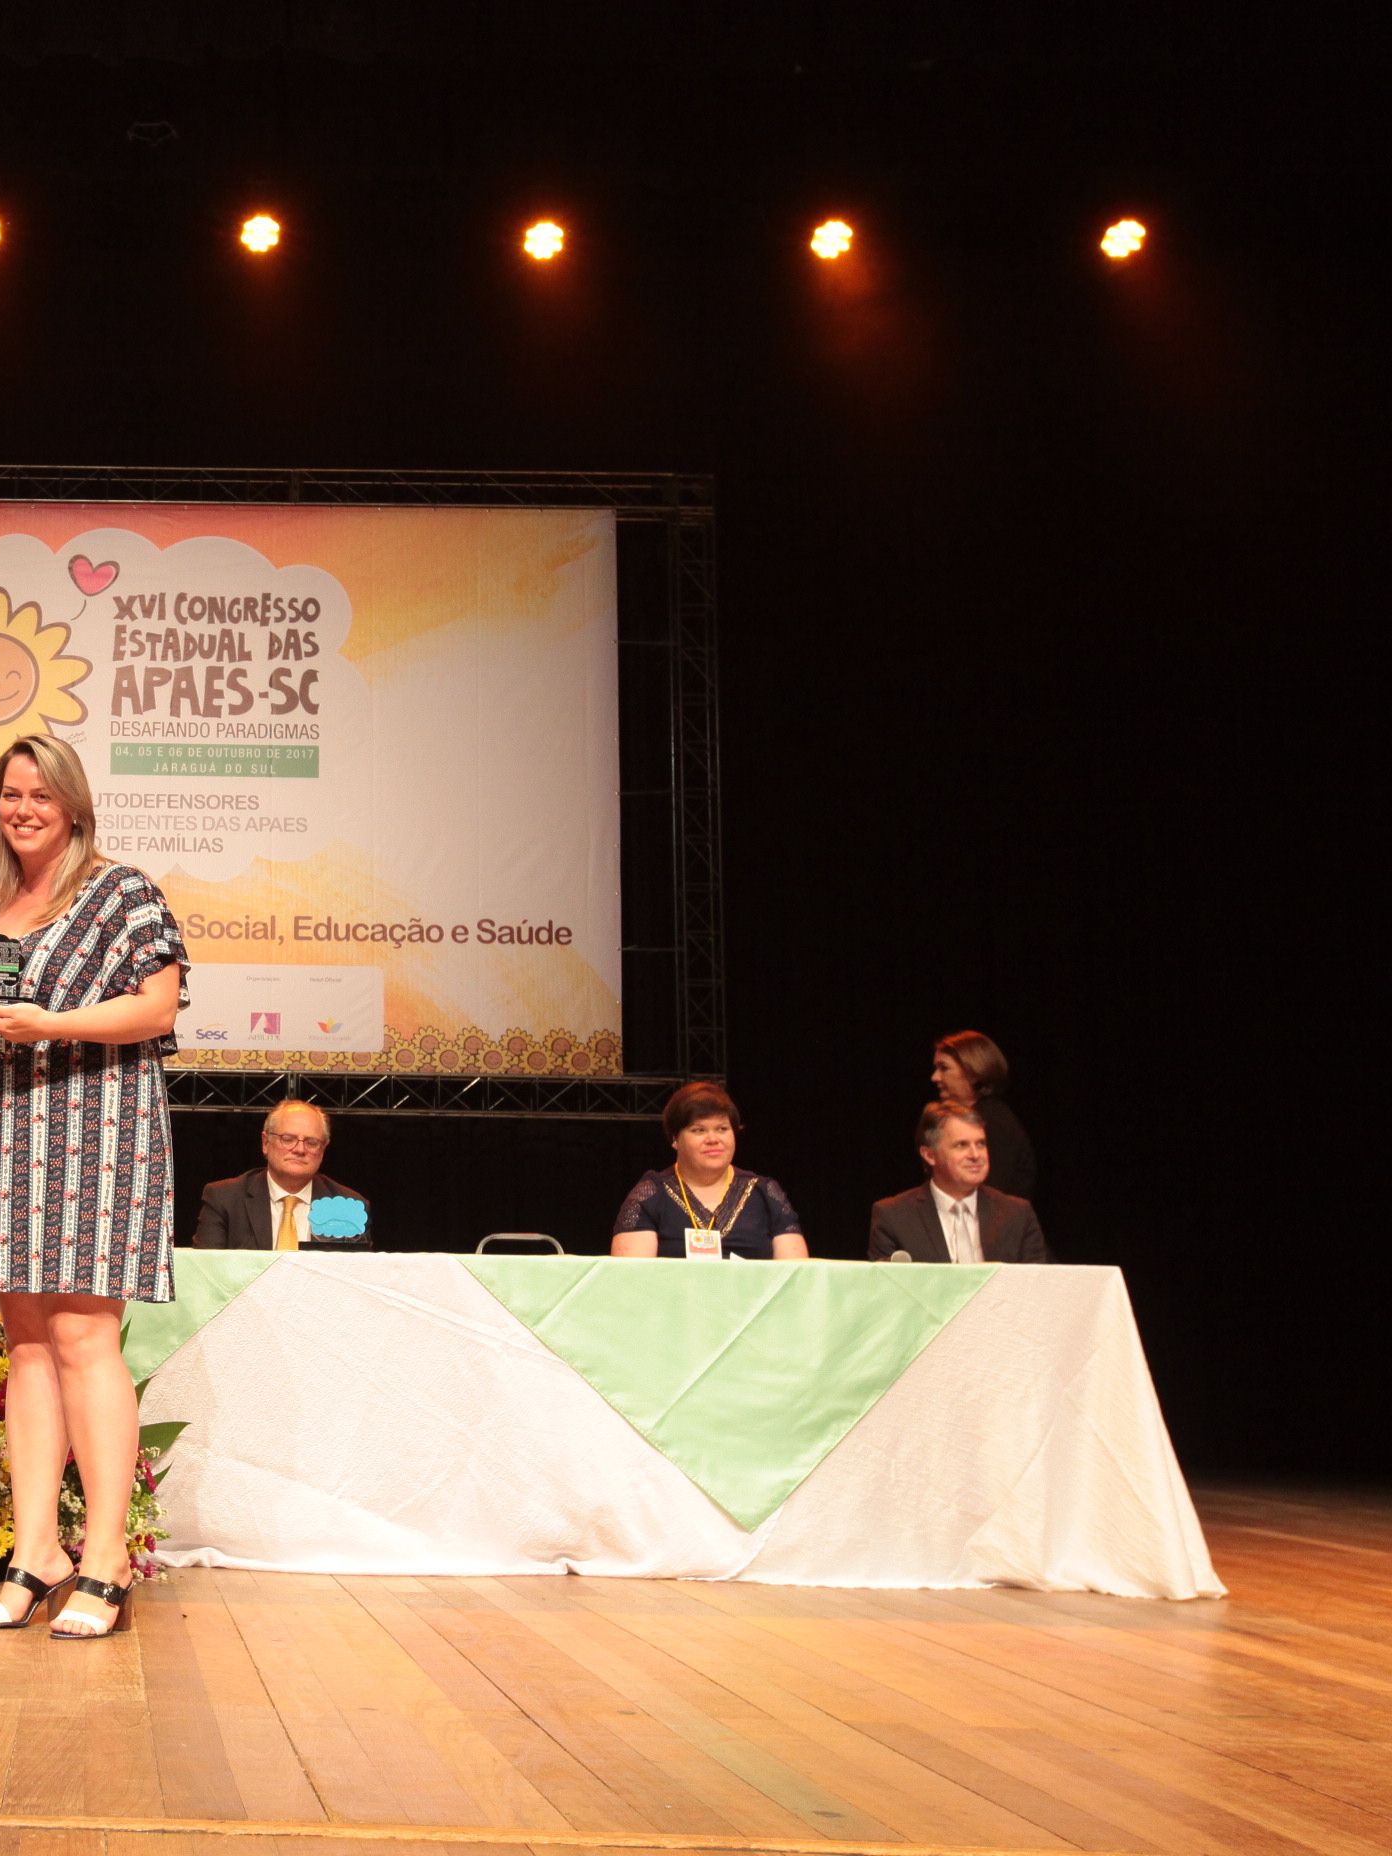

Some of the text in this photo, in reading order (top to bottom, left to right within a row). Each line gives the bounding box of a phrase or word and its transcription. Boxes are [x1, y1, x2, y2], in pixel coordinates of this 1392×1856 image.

[112, 592, 321, 627] XVI CONGRESSO
[112, 624, 320, 663] ESTADUAL DAS
[111, 664, 320, 719] APAES-SC
[110, 721, 320, 740] DESAFIANDO PARADIGMAS
[138, 746, 152, 757] 05
[158, 747, 164, 757] E
[168, 747, 182, 757] 06
[188, 747, 202, 758] DE
[207, 747, 261, 759] OUTUBRO
[266, 748, 281, 759] DE
[286, 749, 314, 760] 2017
[153, 761, 276, 775] JARAGUÁ DO SUL
[93, 792, 260, 811] UTODEFENSORES
[95, 813, 198, 831] ESIDENTES
[202, 815, 241, 832] DAS
[244, 816, 308, 833] APAES
[106, 835, 133, 852] DE
[136, 833, 224, 854] FAMÍLIAS
[293, 915, 445, 950] Educação
[450, 926, 469, 945] e
[476, 918, 573, 946] Saúde
[195, 1027, 229, 1041] Sesc
